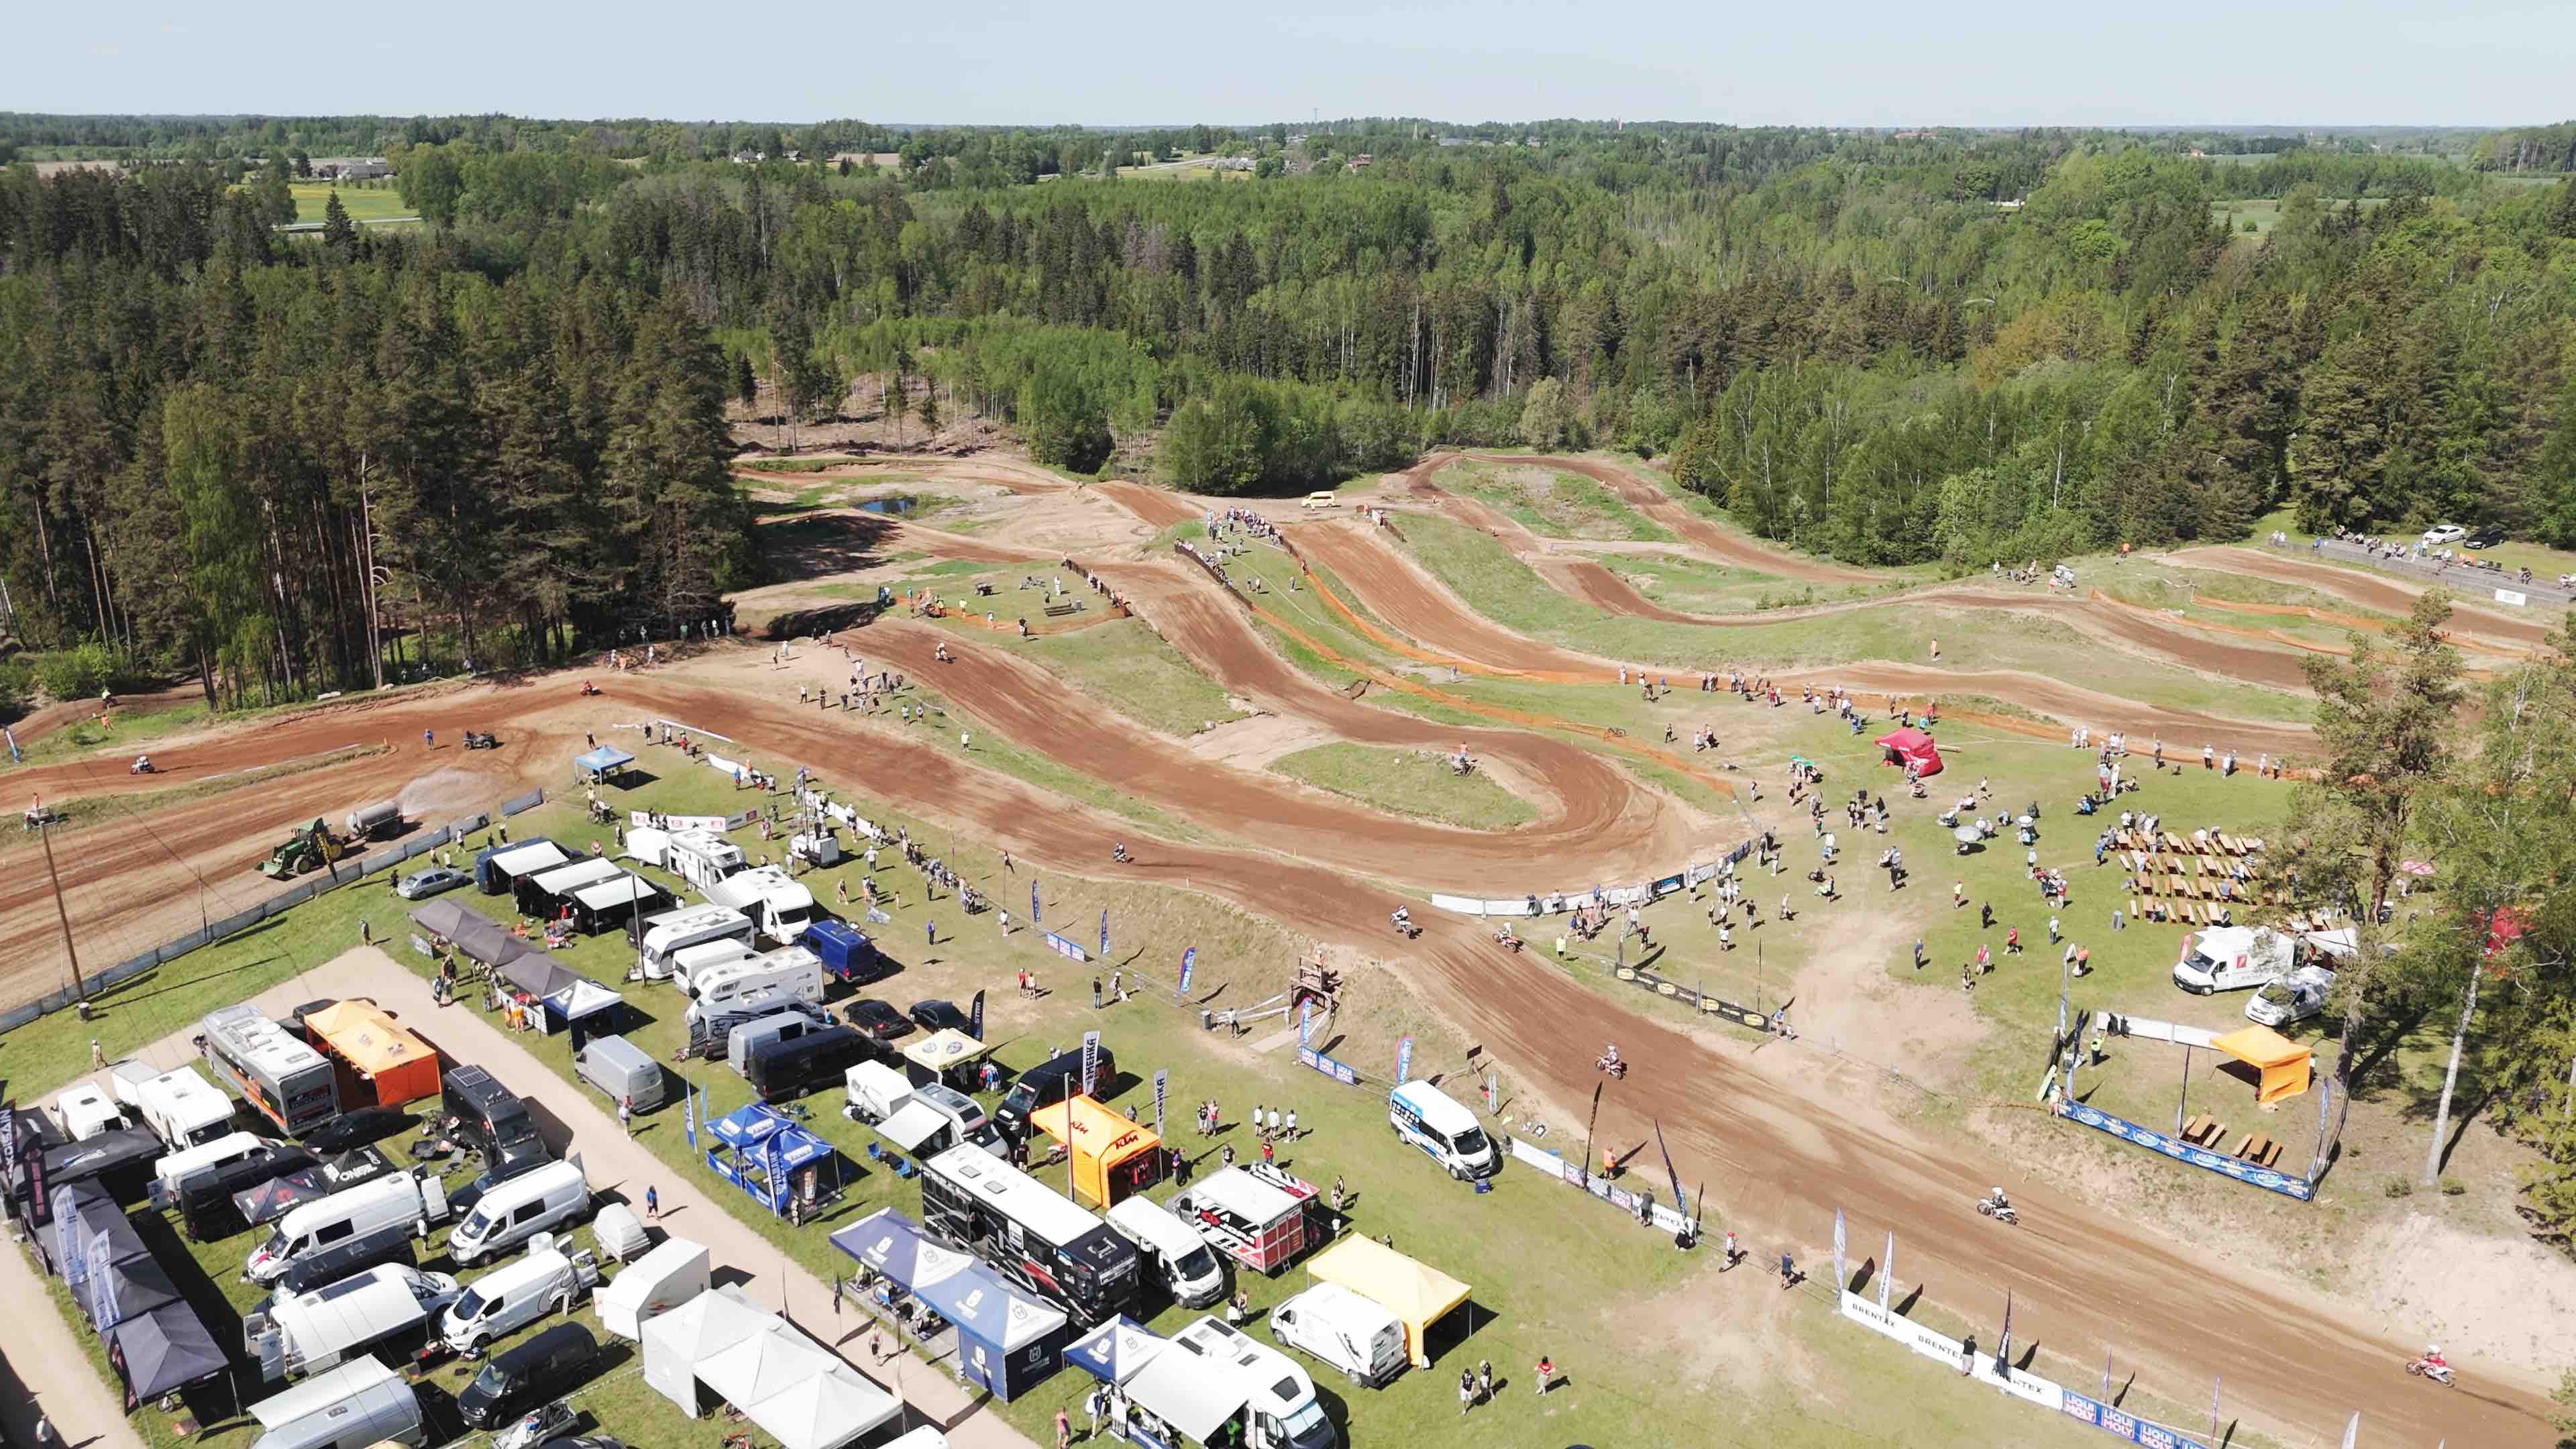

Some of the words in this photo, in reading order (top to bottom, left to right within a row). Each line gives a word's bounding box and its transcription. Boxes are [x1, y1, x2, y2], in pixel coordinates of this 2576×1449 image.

[1116, 1134, 1138, 1149] KTM
[2065, 1403, 2094, 1421] MOLY
[2066, 1393, 2094, 1412] LIQUI
[2104, 1408, 2133, 1428] LIQUI
[2104, 1419, 2133, 1438] MOLY
[2141, 1424, 2173, 1443] LIQUI
